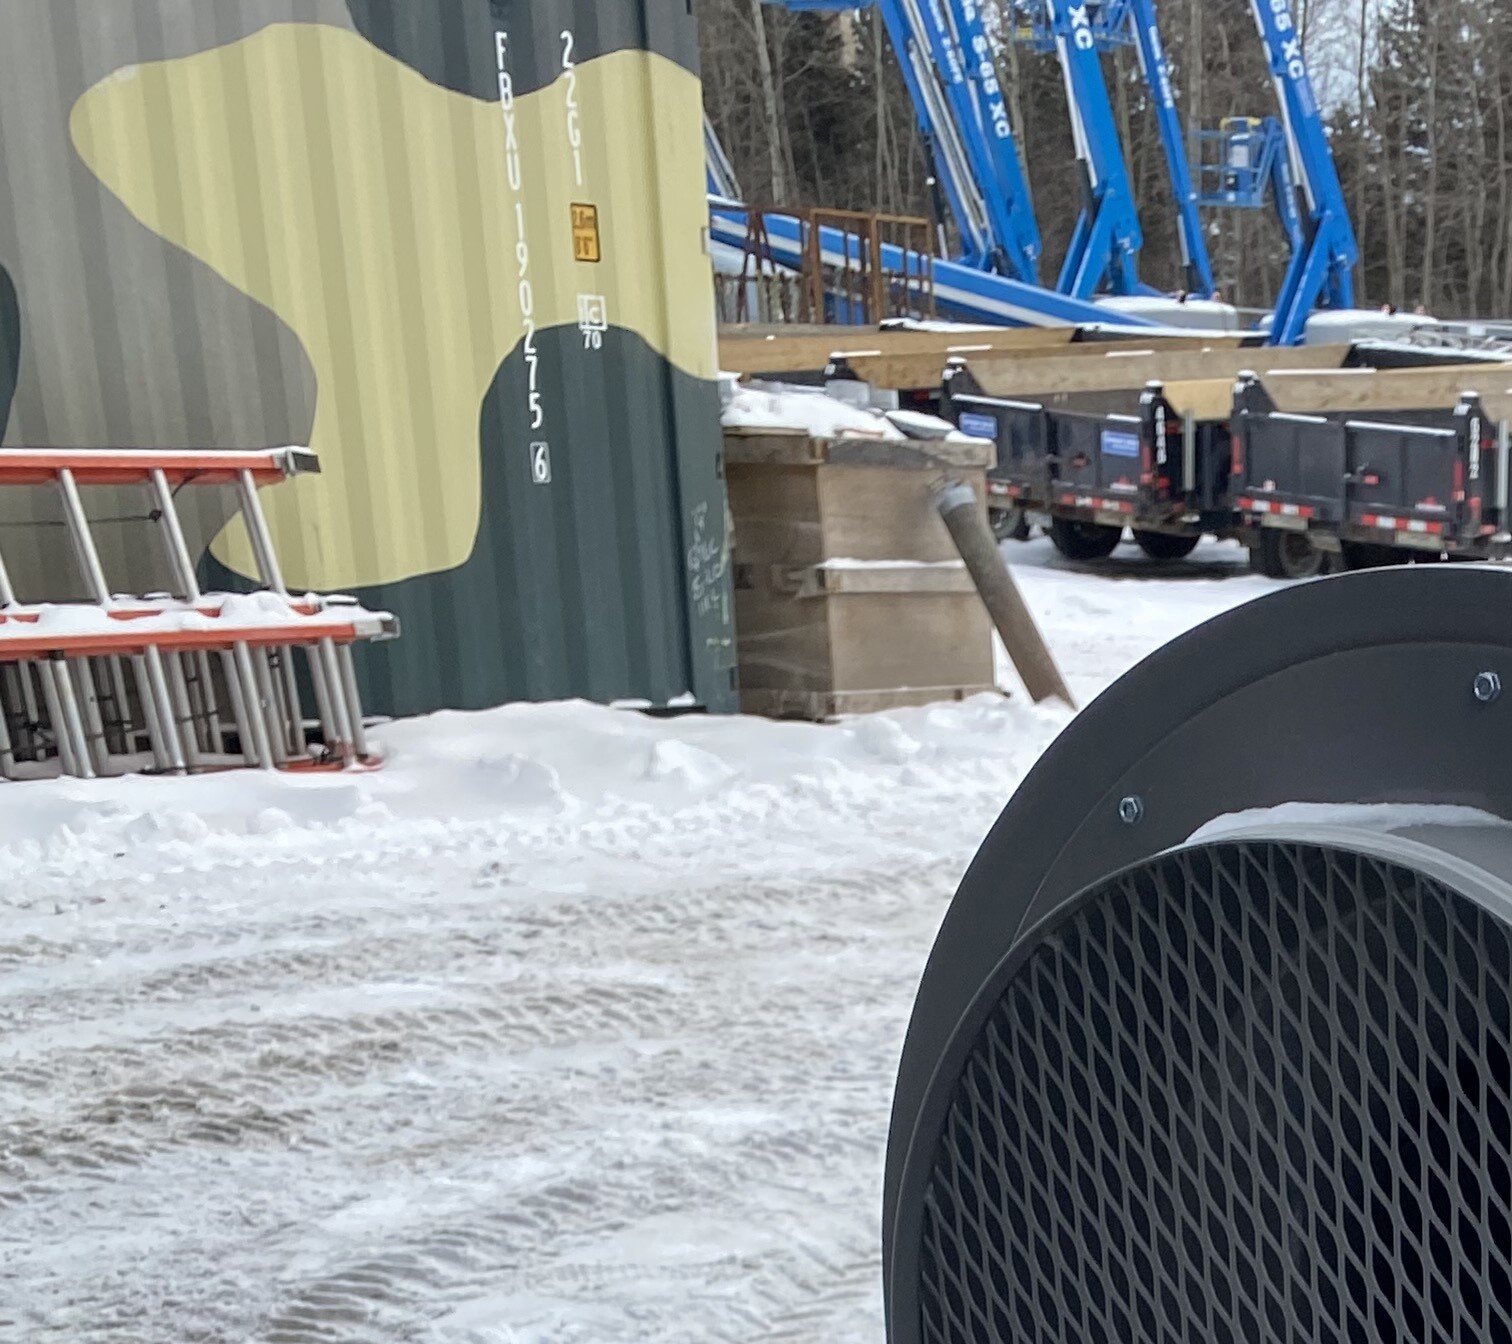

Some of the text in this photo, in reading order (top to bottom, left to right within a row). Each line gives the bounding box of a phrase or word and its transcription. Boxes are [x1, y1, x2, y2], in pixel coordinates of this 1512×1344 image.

[1068, 5, 1093, 49] XC
[1281, 38, 1304, 80] XC
[560, 30, 582, 186] 22G1
[989, 101, 1010, 139] XC
[495, 31, 548, 481] FBXU 190275 6
[582, 330, 603, 350] 70
